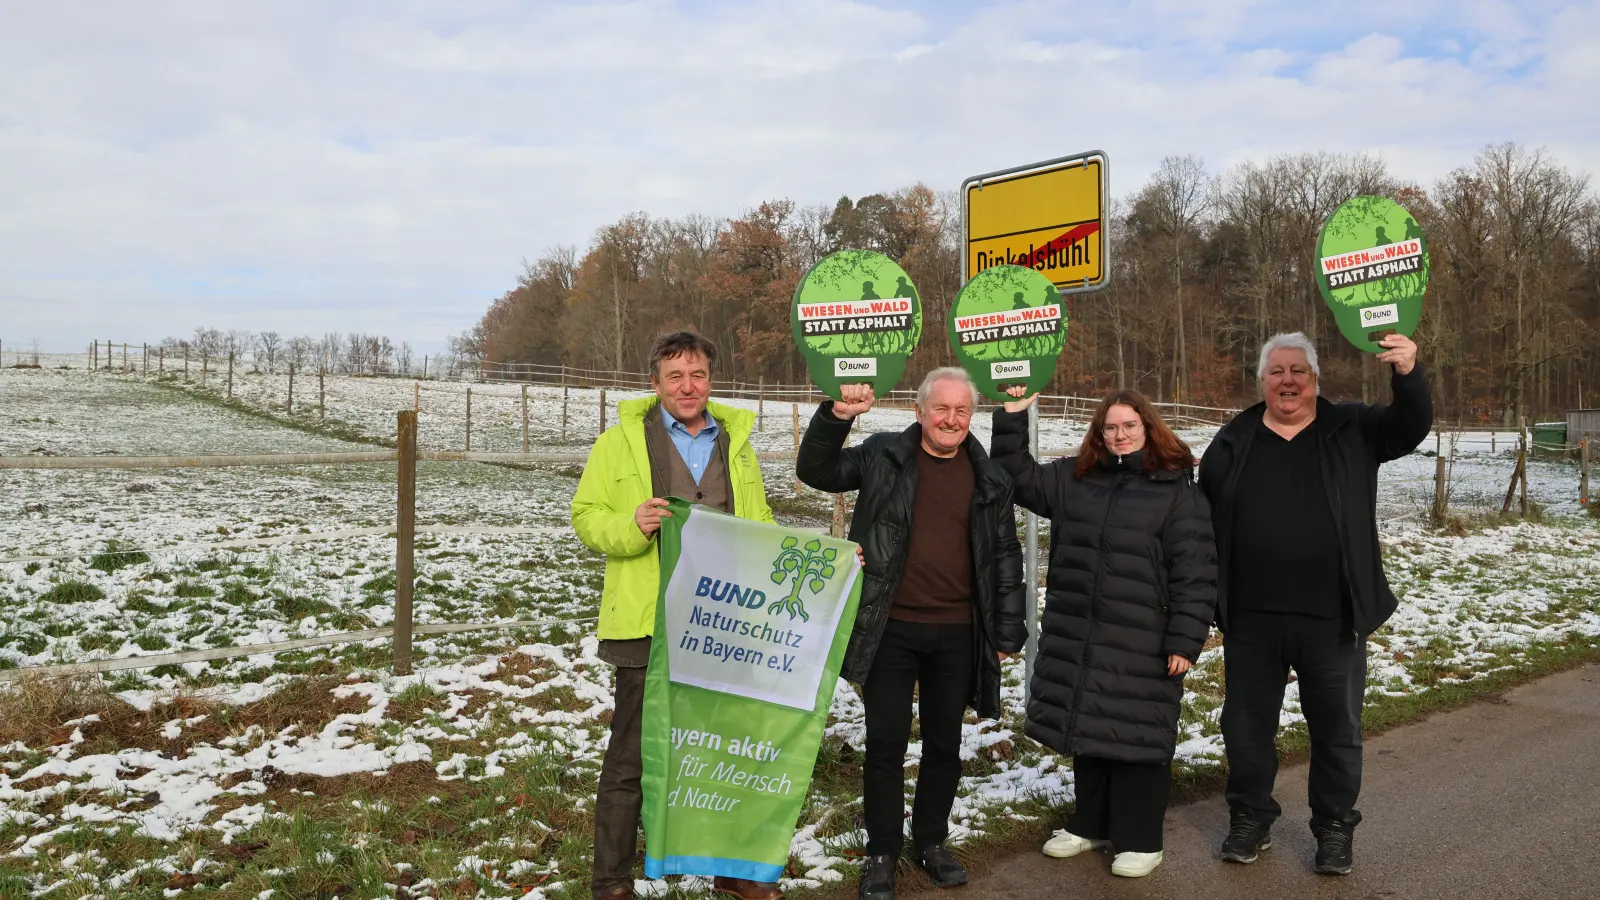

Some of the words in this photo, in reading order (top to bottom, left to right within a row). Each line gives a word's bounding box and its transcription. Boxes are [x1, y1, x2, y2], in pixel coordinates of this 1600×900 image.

[1325, 252, 1369, 271] WIESEN
[1385, 242, 1418, 258] WALD
[1330, 269, 1364, 286] STATT
[1368, 258, 1419, 278] ASPHALT
[802, 305, 852, 317] WIESEN
[870, 301, 908, 312] WALD
[958, 314, 1005, 329] WIESEN
[1022, 308, 1057, 320] WALD
[1373, 310, 1391, 318] BUND
[805, 320, 845, 332] STATT
[848, 316, 908, 330] ASPHALT
[962, 328, 998, 342] STATT
[1002, 321, 1056, 337] ASPHALT
[695, 576, 766, 609] BUND
[689, 606, 803, 648] Naturschutz
[680, 631, 699, 651] in
[702, 636, 763, 663] Bayern
[767, 654, 795, 672] e.V.
[728, 736, 781, 762] aktiv
[676, 755, 708, 780] für
[710, 761, 792, 795] Mensch
[682, 787, 740, 812] Natur
